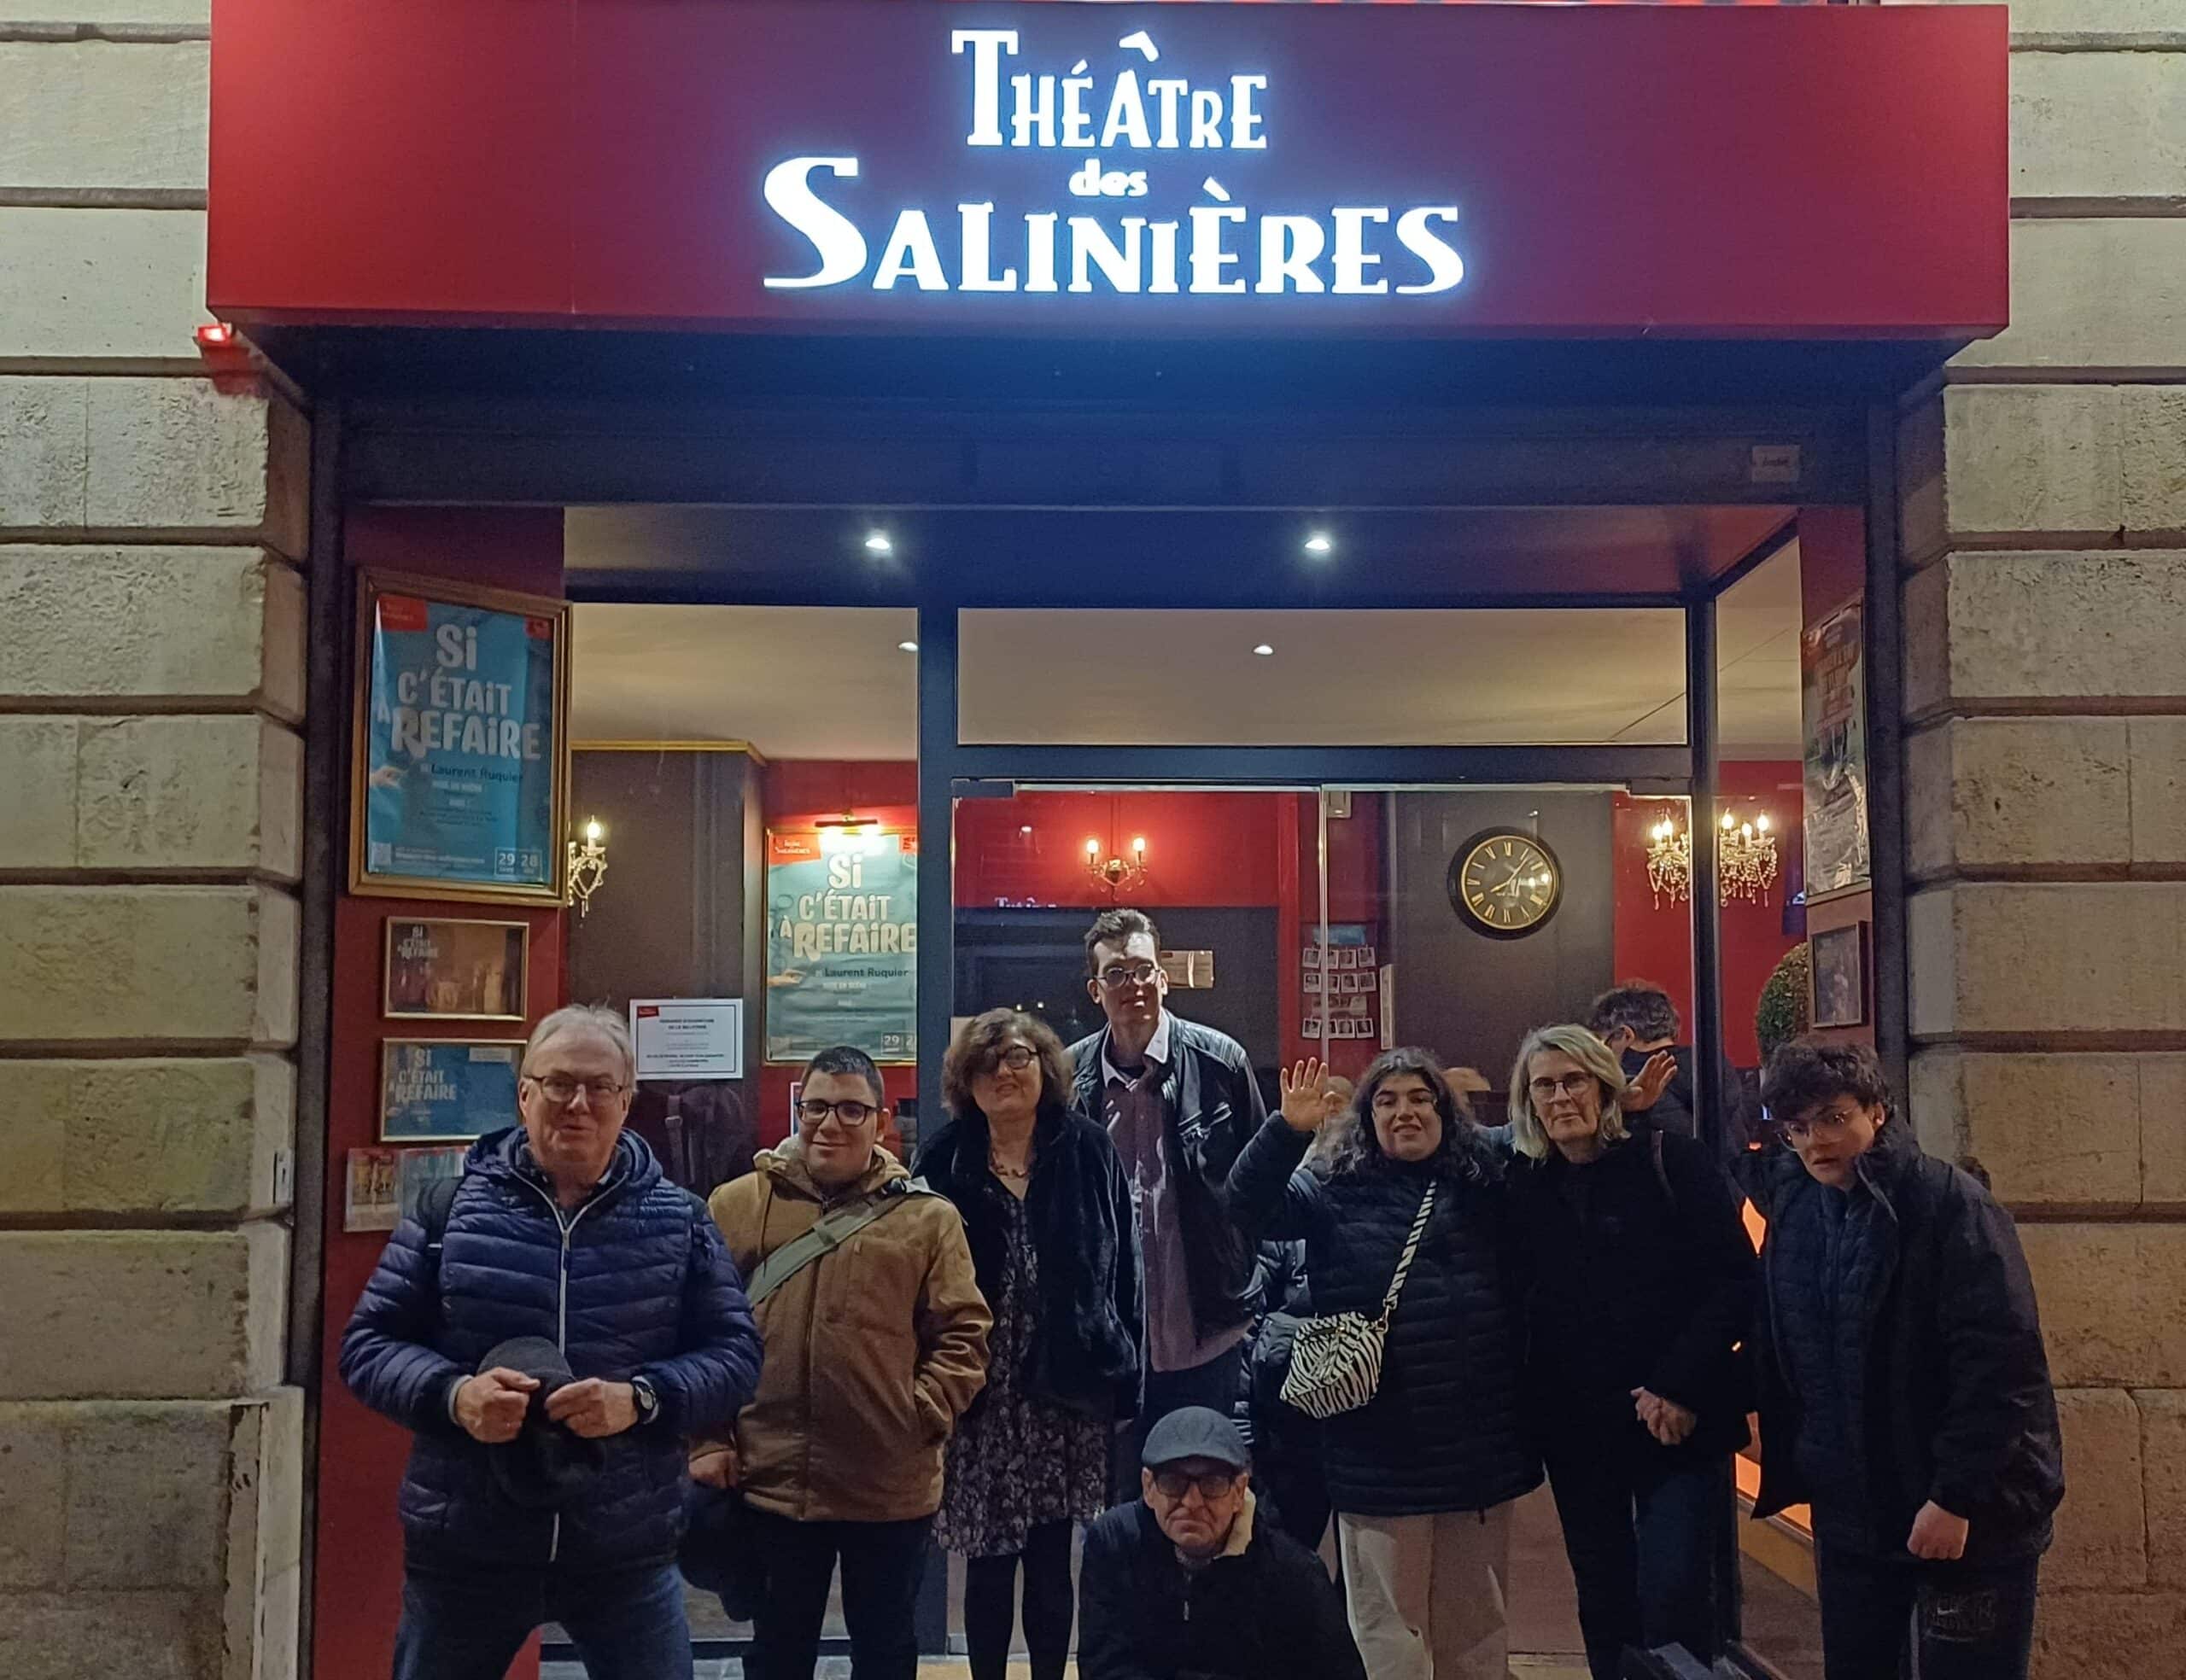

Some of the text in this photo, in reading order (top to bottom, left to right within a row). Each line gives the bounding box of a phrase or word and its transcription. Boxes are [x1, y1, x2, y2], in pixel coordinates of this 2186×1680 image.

[951, 29, 1268, 149] THÉÂTRE
[1069, 159, 1148, 197] des
[763, 156, 1464, 295] SALINIÈRES
[436, 623, 477, 671] Si
[498, 853, 515, 866] 29
[828, 854, 862, 890] Si
[825, 967, 865, 977] Laurent
[867, 967, 909, 978] Ruquier
